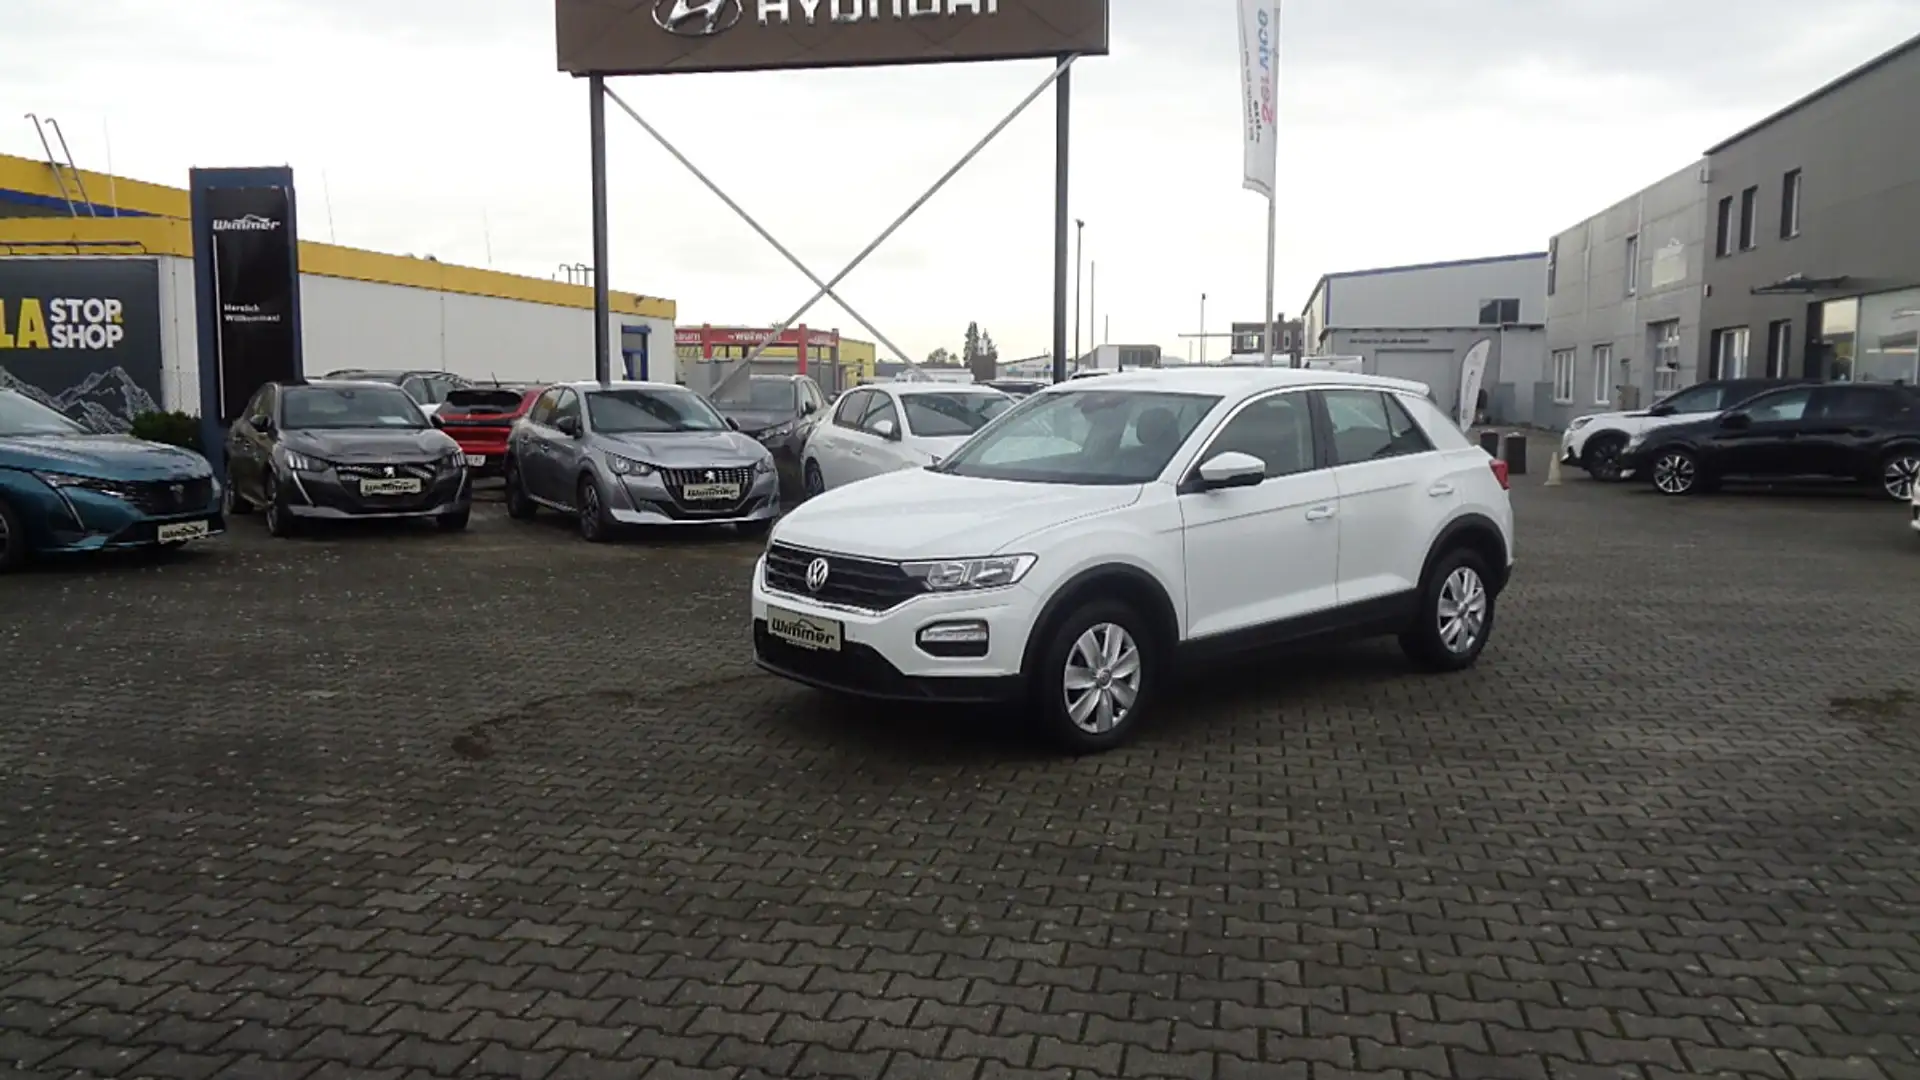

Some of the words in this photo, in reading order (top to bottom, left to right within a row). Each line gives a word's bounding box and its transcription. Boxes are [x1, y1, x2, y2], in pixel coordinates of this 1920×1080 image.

[213, 217, 281, 230] Wimmer
[50, 298, 122, 323] STOP
[52, 324, 124, 349] SHOP
[772, 618, 835, 645] Wimmer
